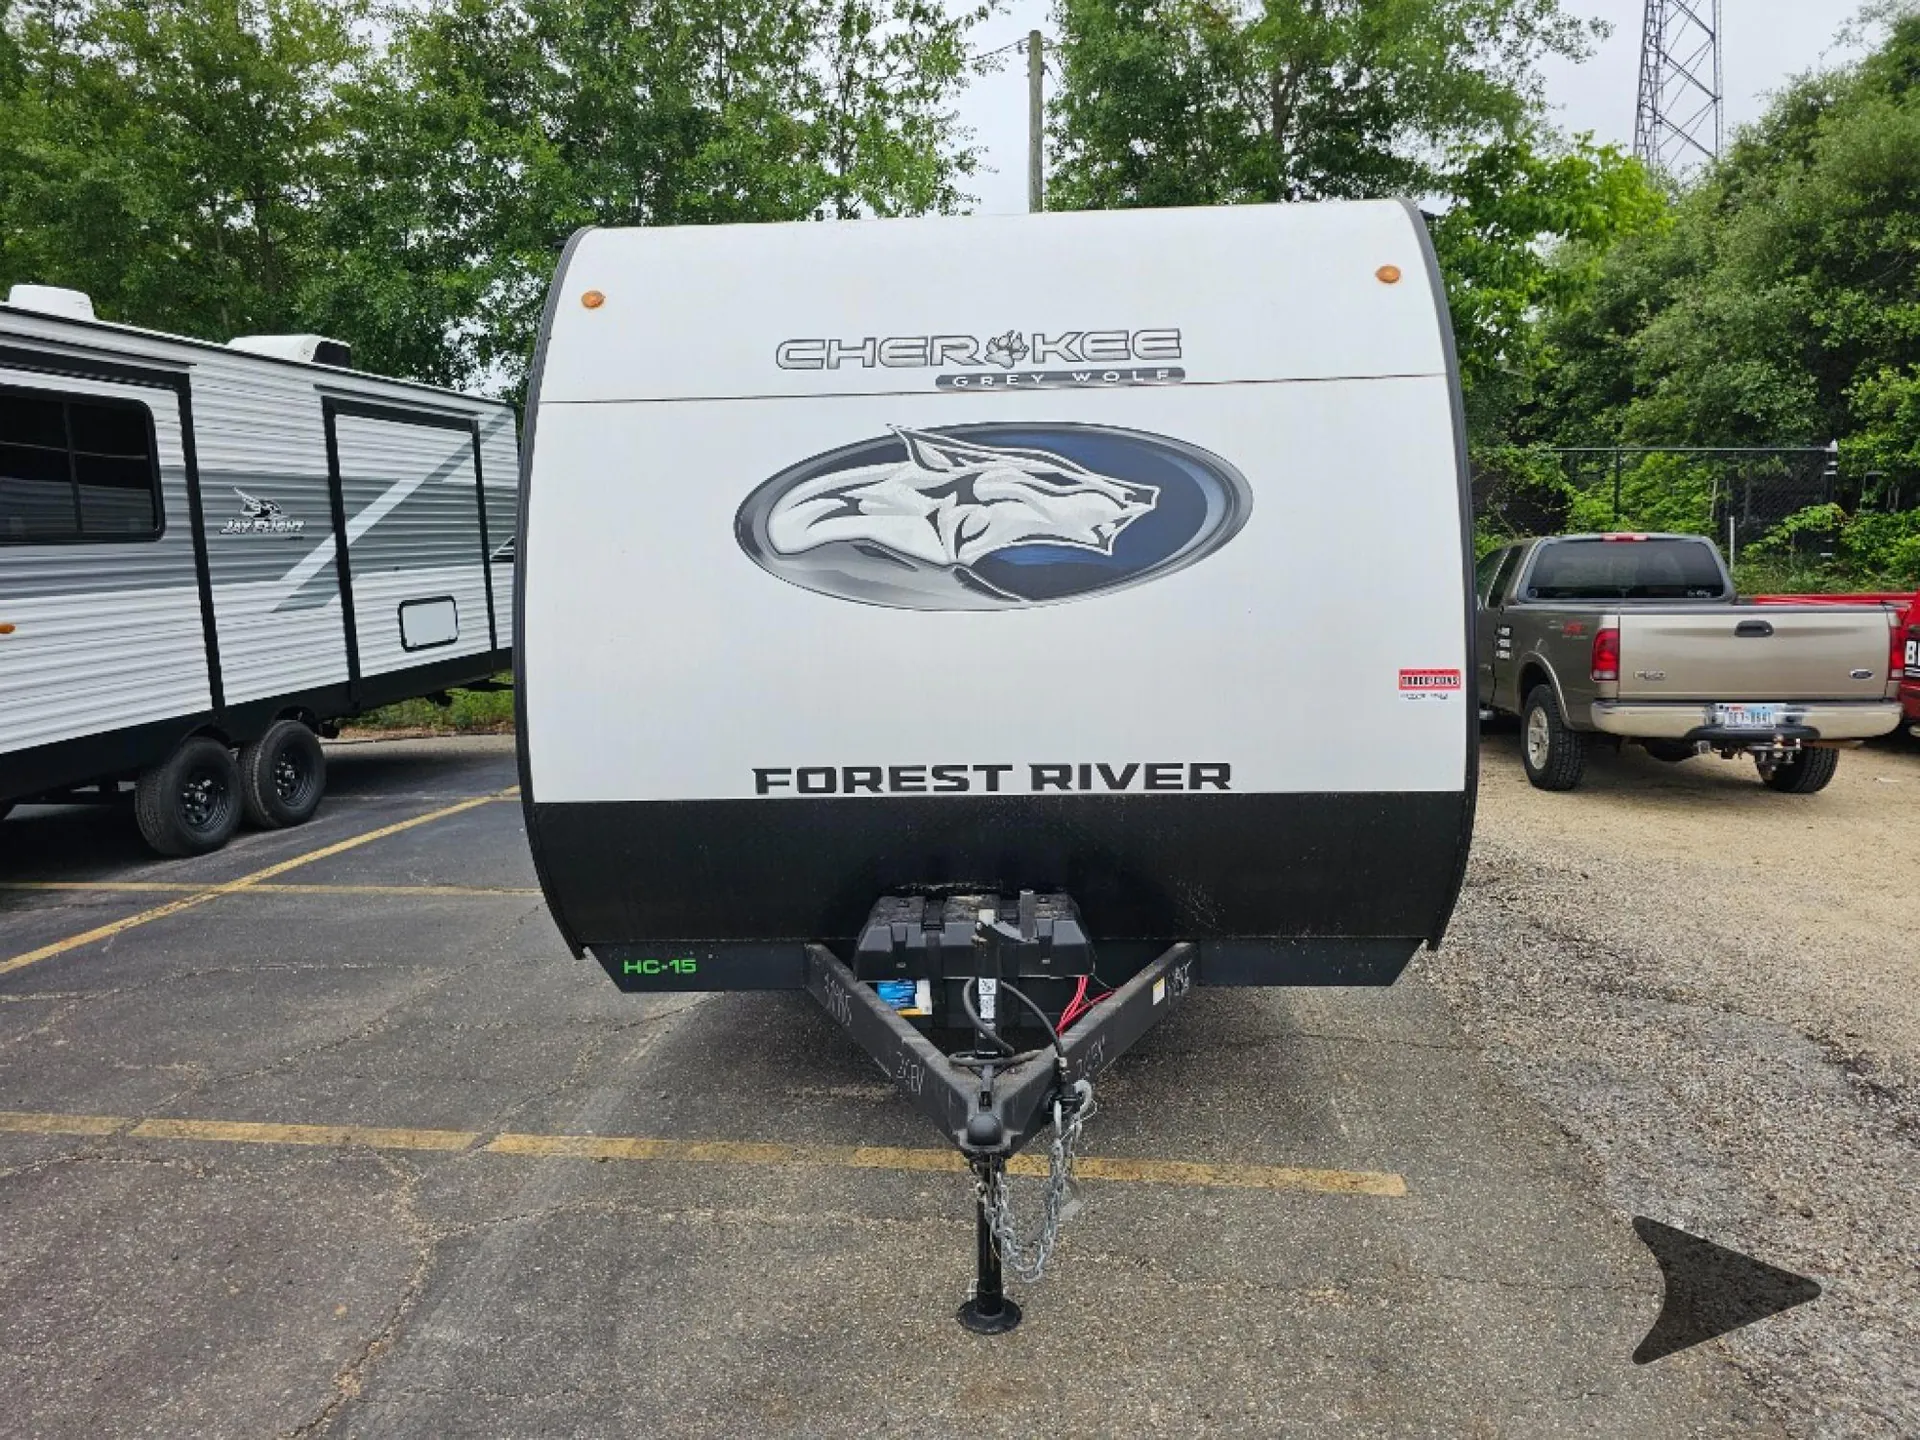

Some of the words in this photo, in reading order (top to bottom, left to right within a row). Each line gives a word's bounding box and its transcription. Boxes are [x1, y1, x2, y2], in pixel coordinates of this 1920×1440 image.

[952, 373, 1044, 387] GREY
[1071, 369, 1169, 383] WOLF
[751, 764, 1013, 795] FOREST
[1028, 763, 1232, 791] RIVER
[623, 959, 697, 974] HC-15
